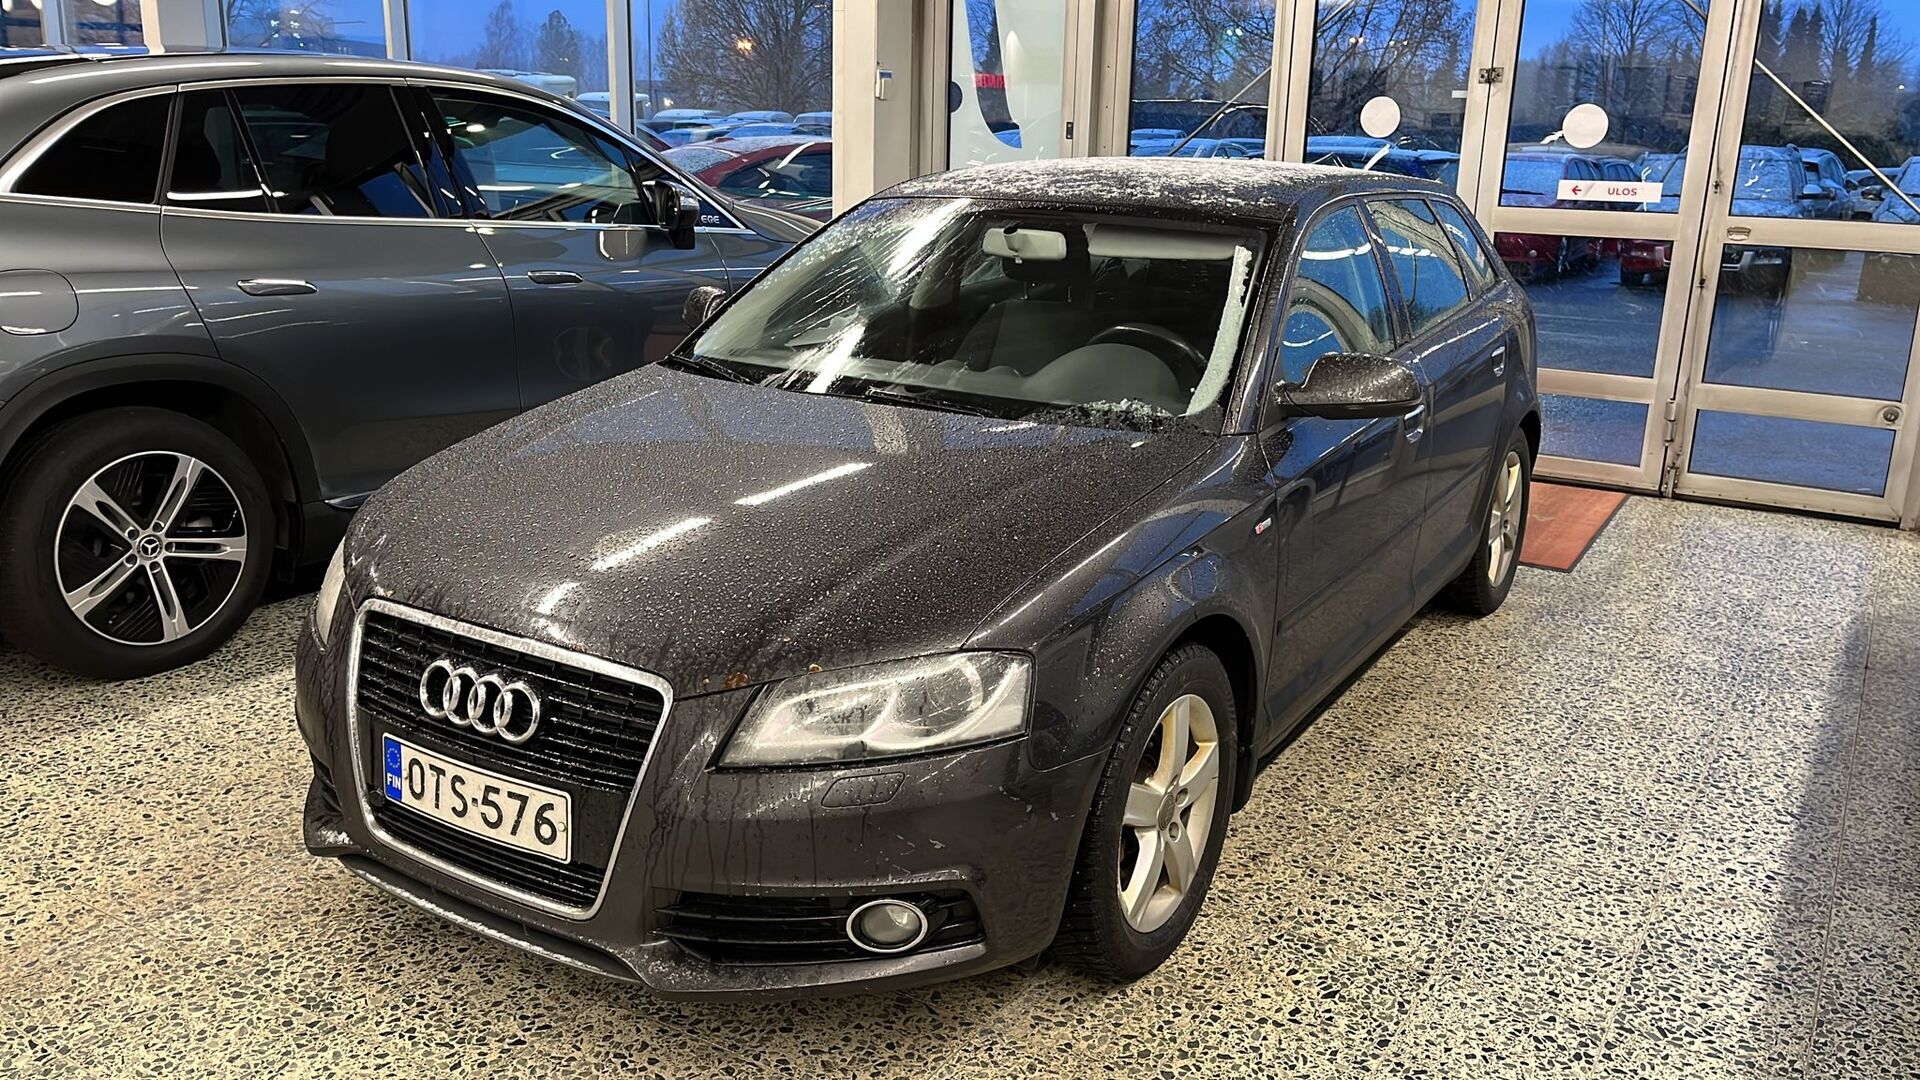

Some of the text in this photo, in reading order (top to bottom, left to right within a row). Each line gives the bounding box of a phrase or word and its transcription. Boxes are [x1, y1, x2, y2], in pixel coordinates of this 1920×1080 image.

[1607, 187, 1637, 196] ULOS
[387, 773, 401, 790] FIN
[408, 758, 557, 846] OTS-576
